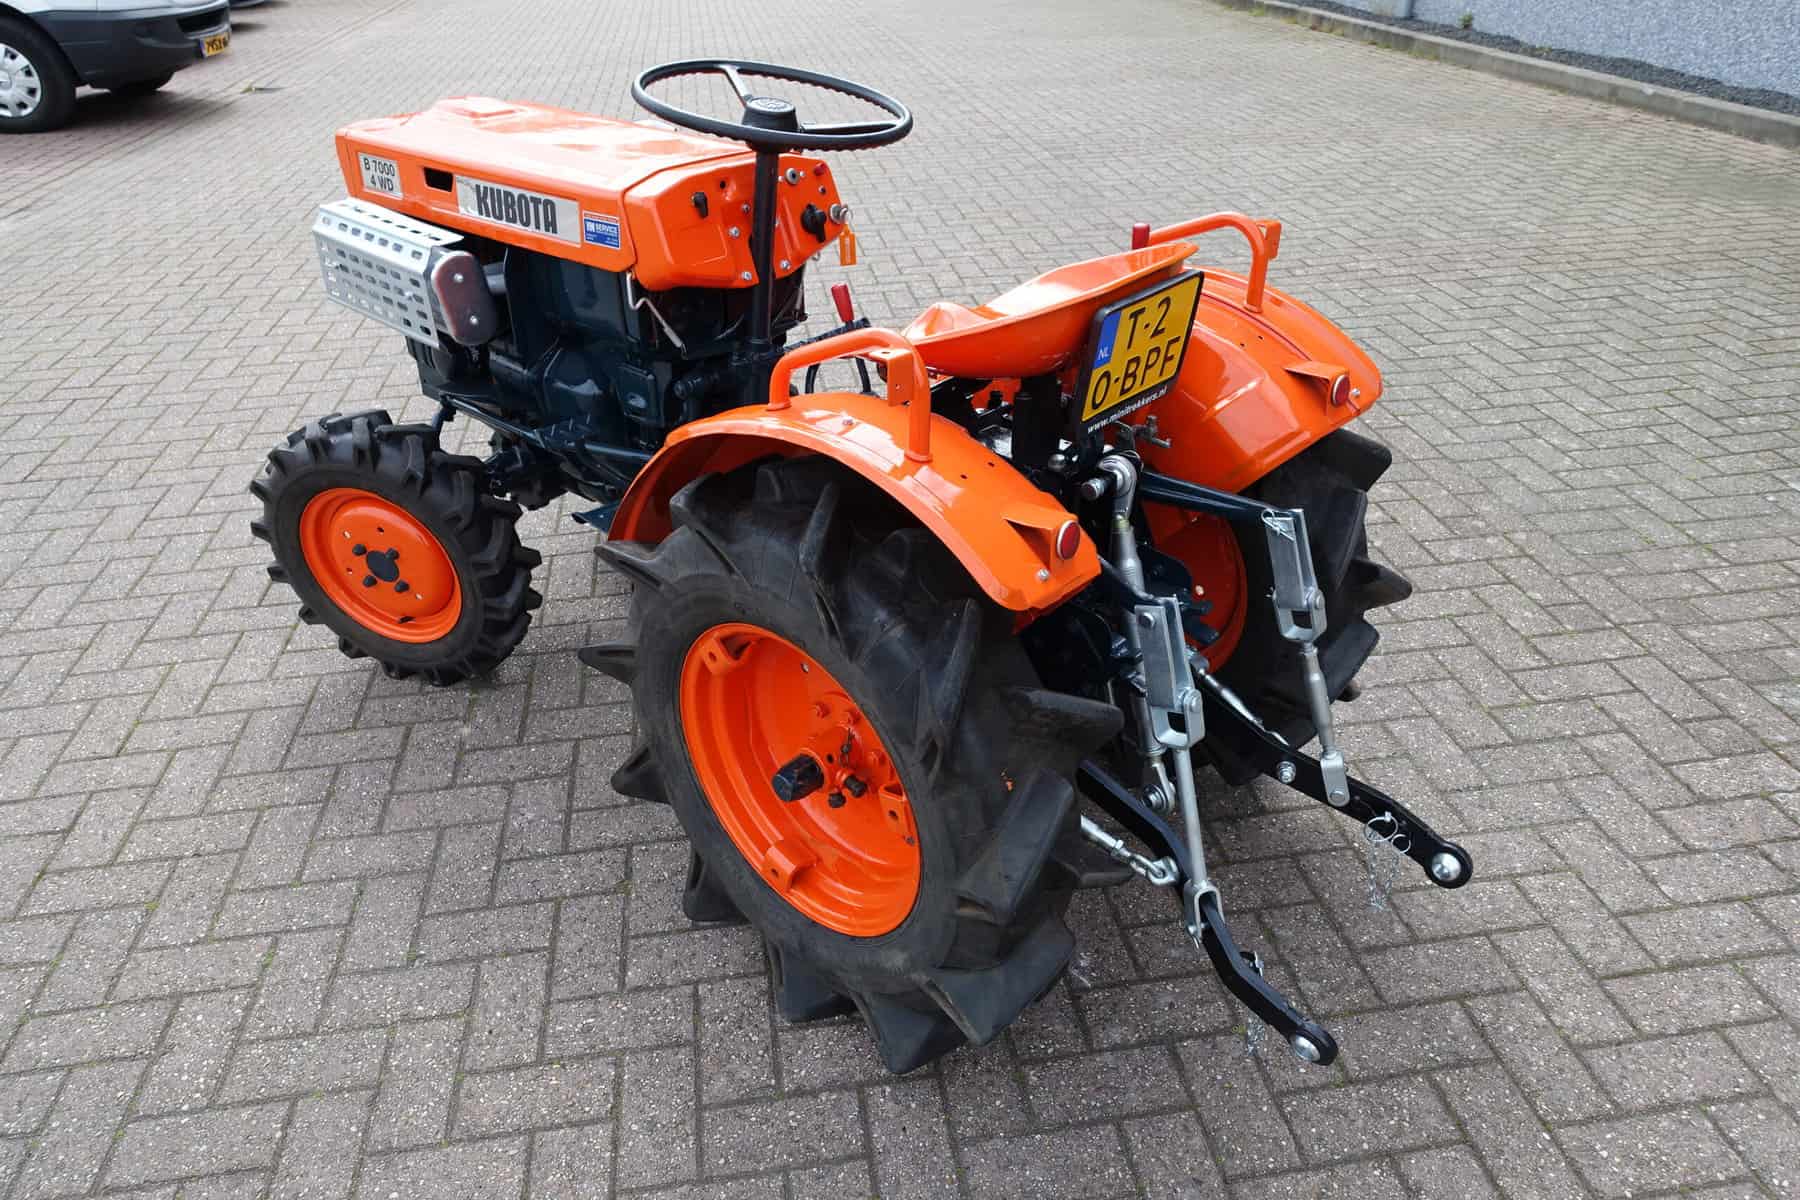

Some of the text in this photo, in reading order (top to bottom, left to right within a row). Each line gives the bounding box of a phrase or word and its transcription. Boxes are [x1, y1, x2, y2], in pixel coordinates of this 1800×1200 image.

[364, 158, 396, 177] B 7000
[370, 175, 394, 192] 4 WD
[475, 184, 558, 235] KUBOTA
[1125, 296, 1172, 350] T-2
[1098, 346, 1109, 360] NL
